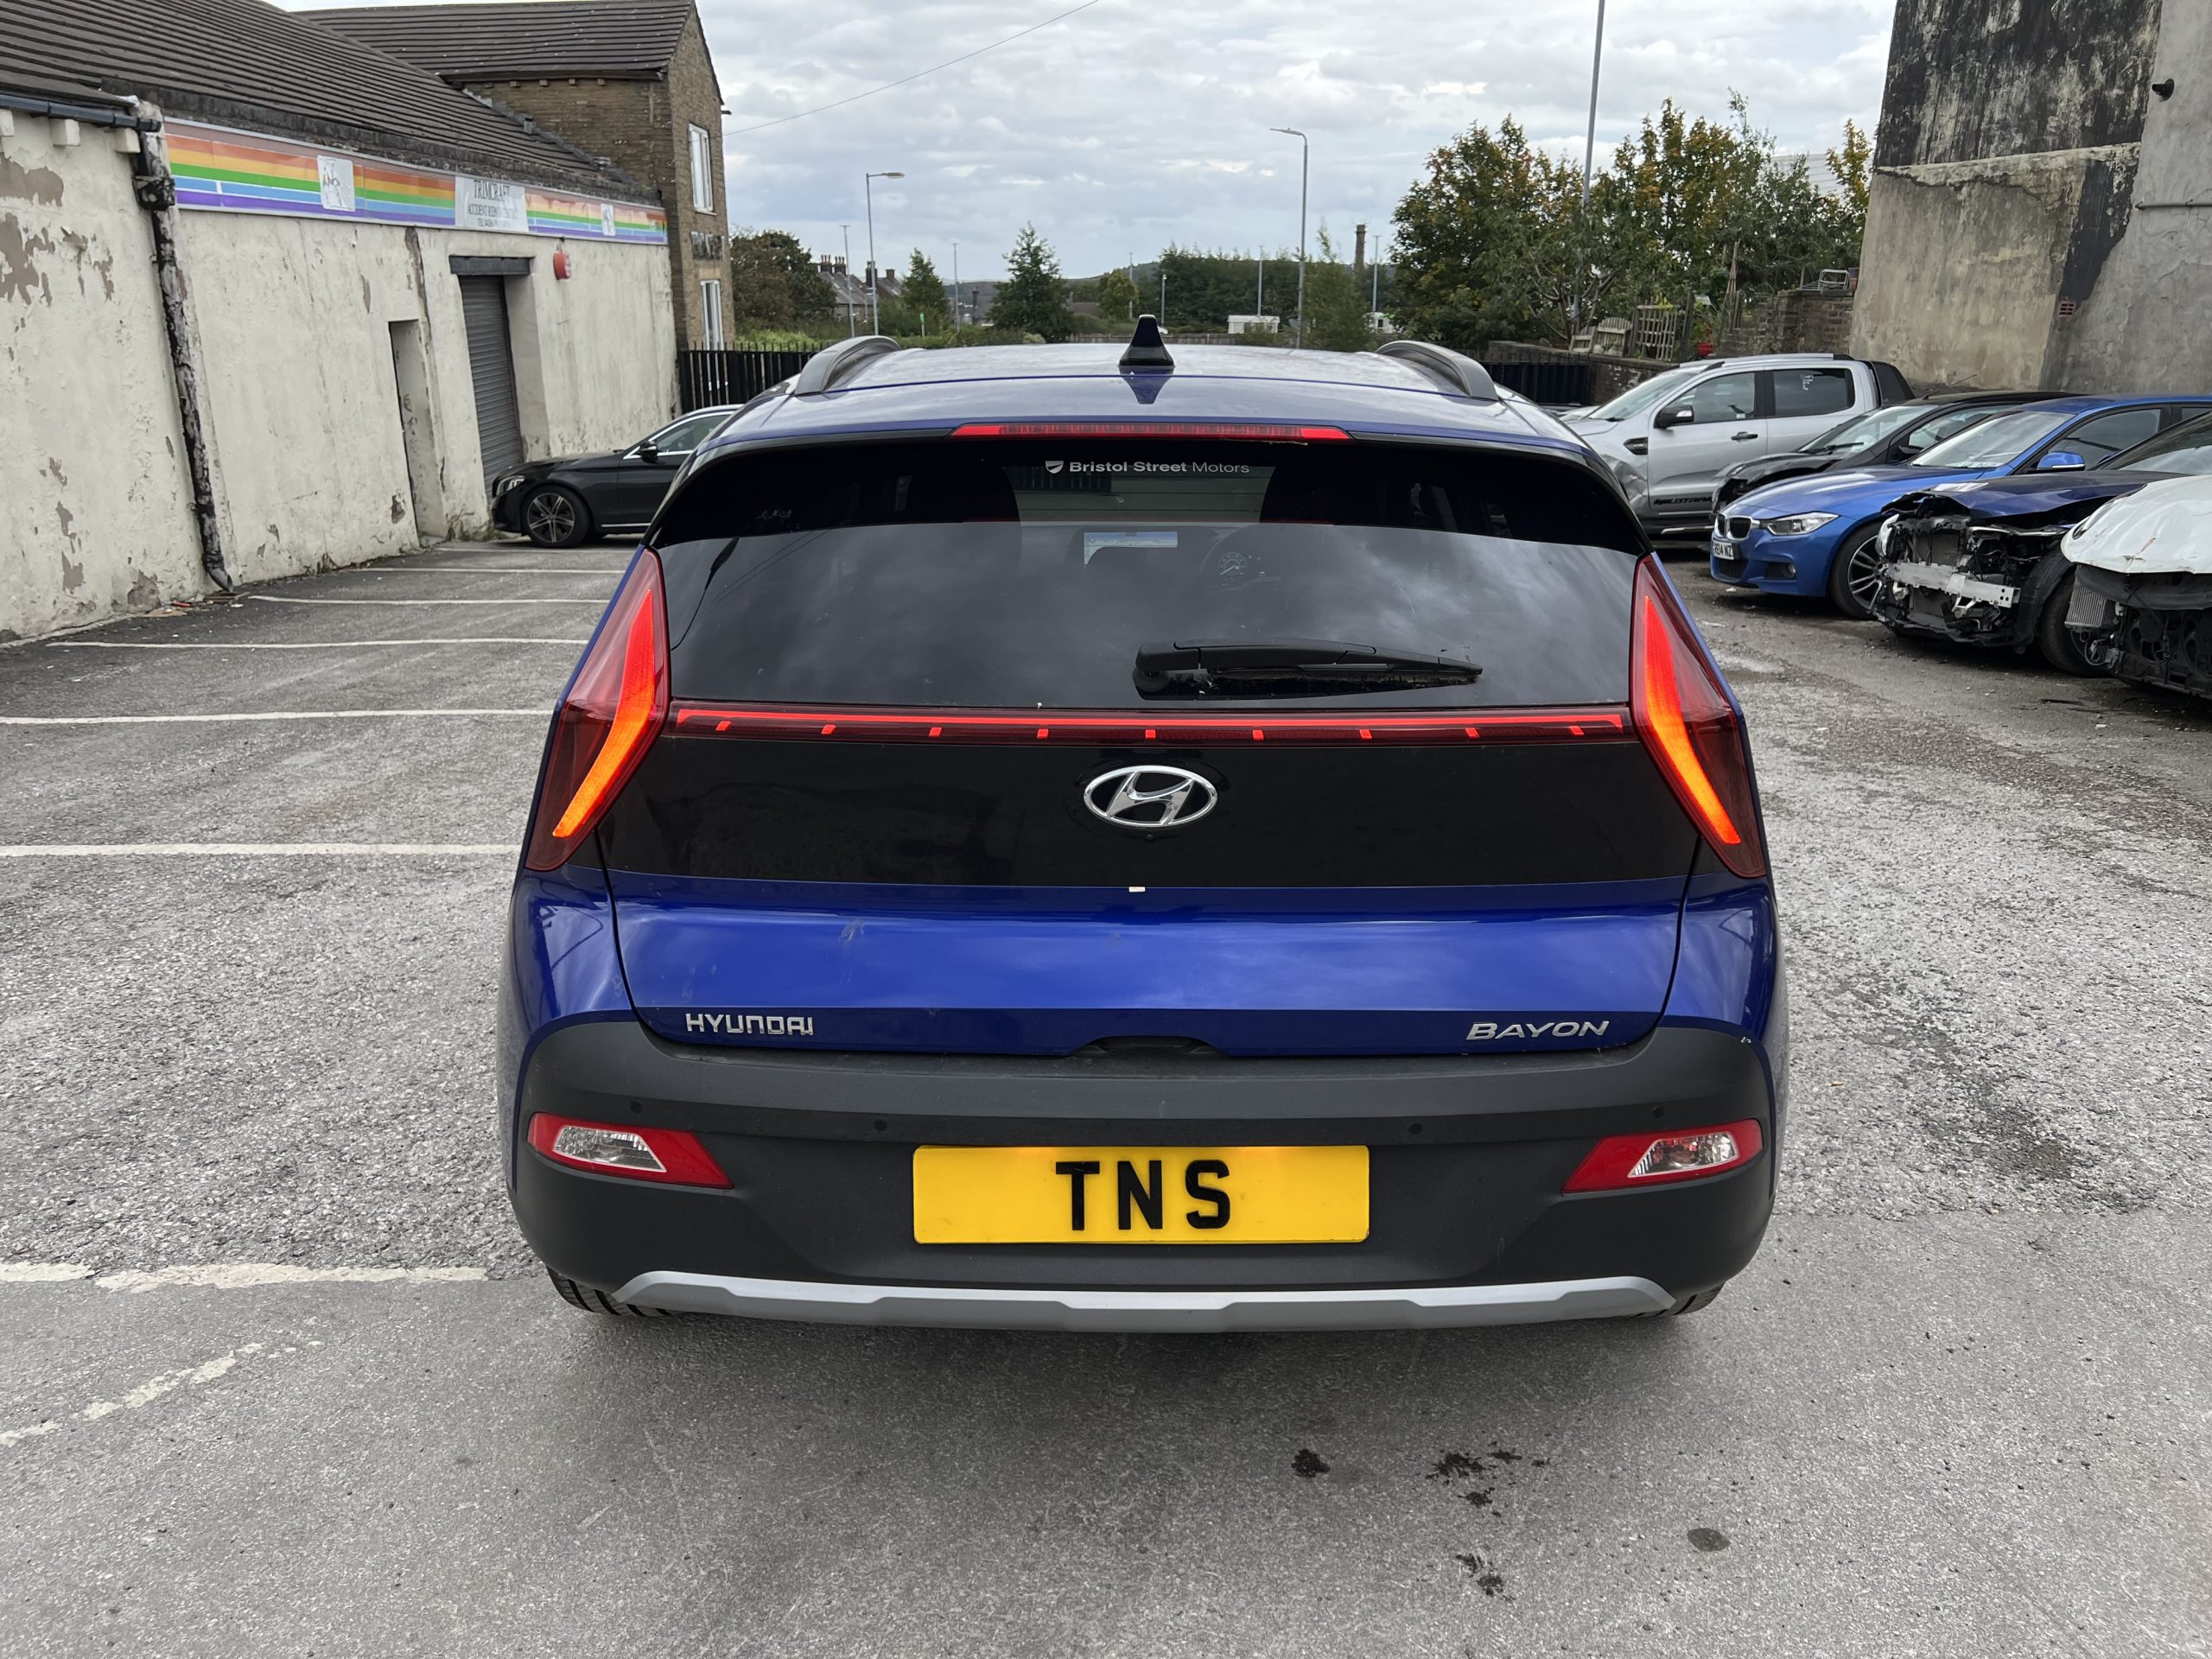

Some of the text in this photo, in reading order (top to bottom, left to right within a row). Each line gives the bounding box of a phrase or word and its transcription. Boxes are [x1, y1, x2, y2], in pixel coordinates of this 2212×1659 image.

[1069, 461, 1249, 474] Bristol Street Motors
[685, 1013, 814, 1035] HYUNDAI
[1465, 1020, 1610, 1039] BAYON
[1055, 1160, 1231, 1230] TNS
